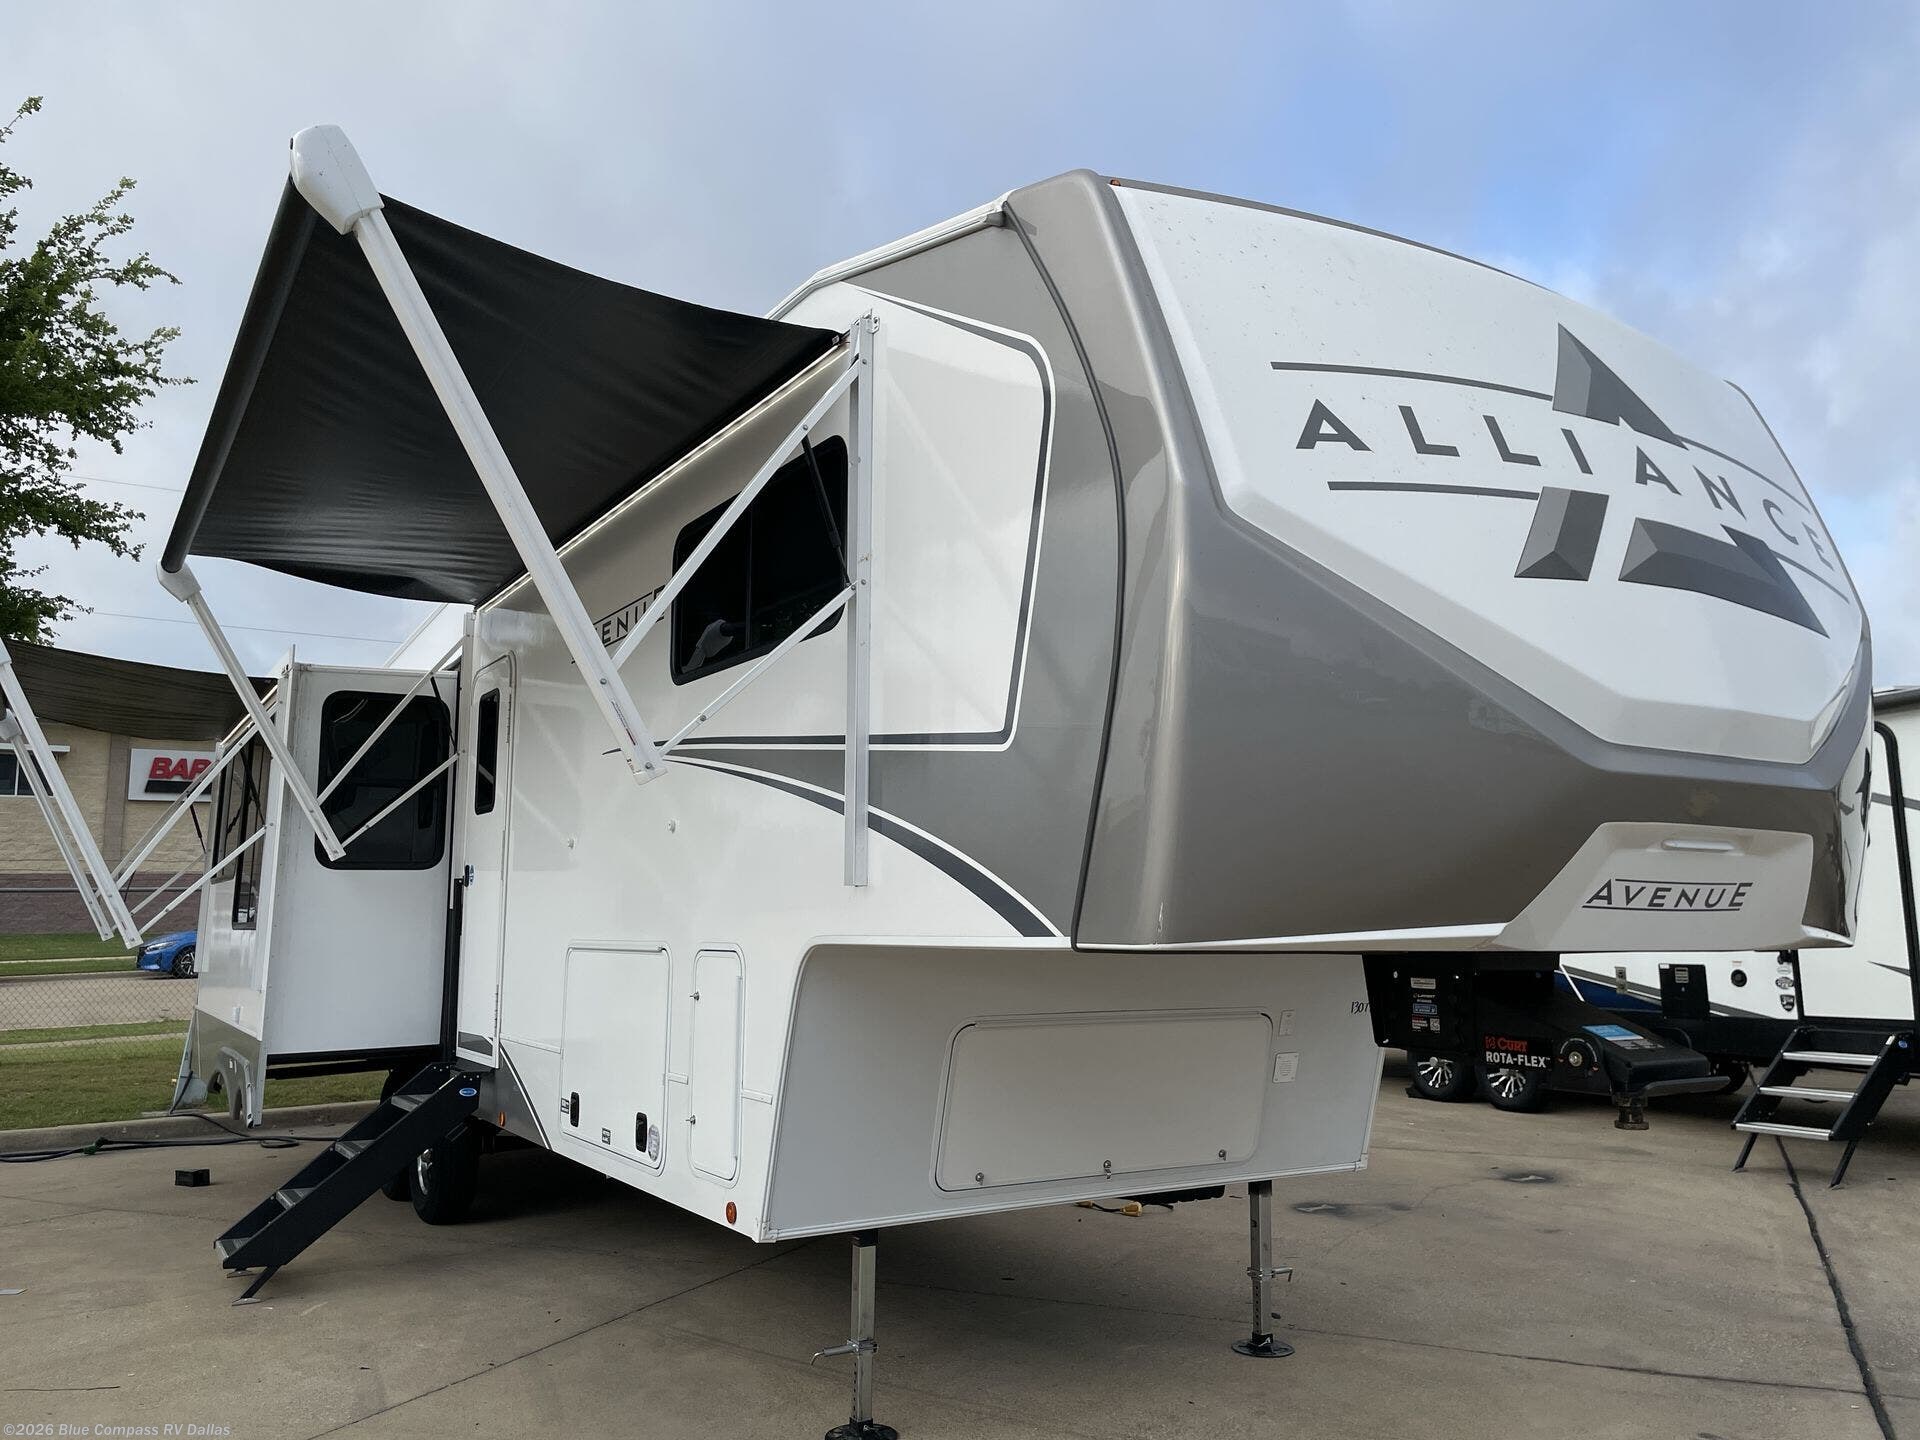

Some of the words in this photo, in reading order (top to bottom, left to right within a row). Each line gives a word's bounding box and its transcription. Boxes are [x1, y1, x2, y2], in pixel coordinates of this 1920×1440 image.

[1296, 399, 1834, 570] ALLIANCE
[1586, 879, 1753, 908] AVENUE
[1485, 1051, 1547, 1068] ROTA-FLEX
